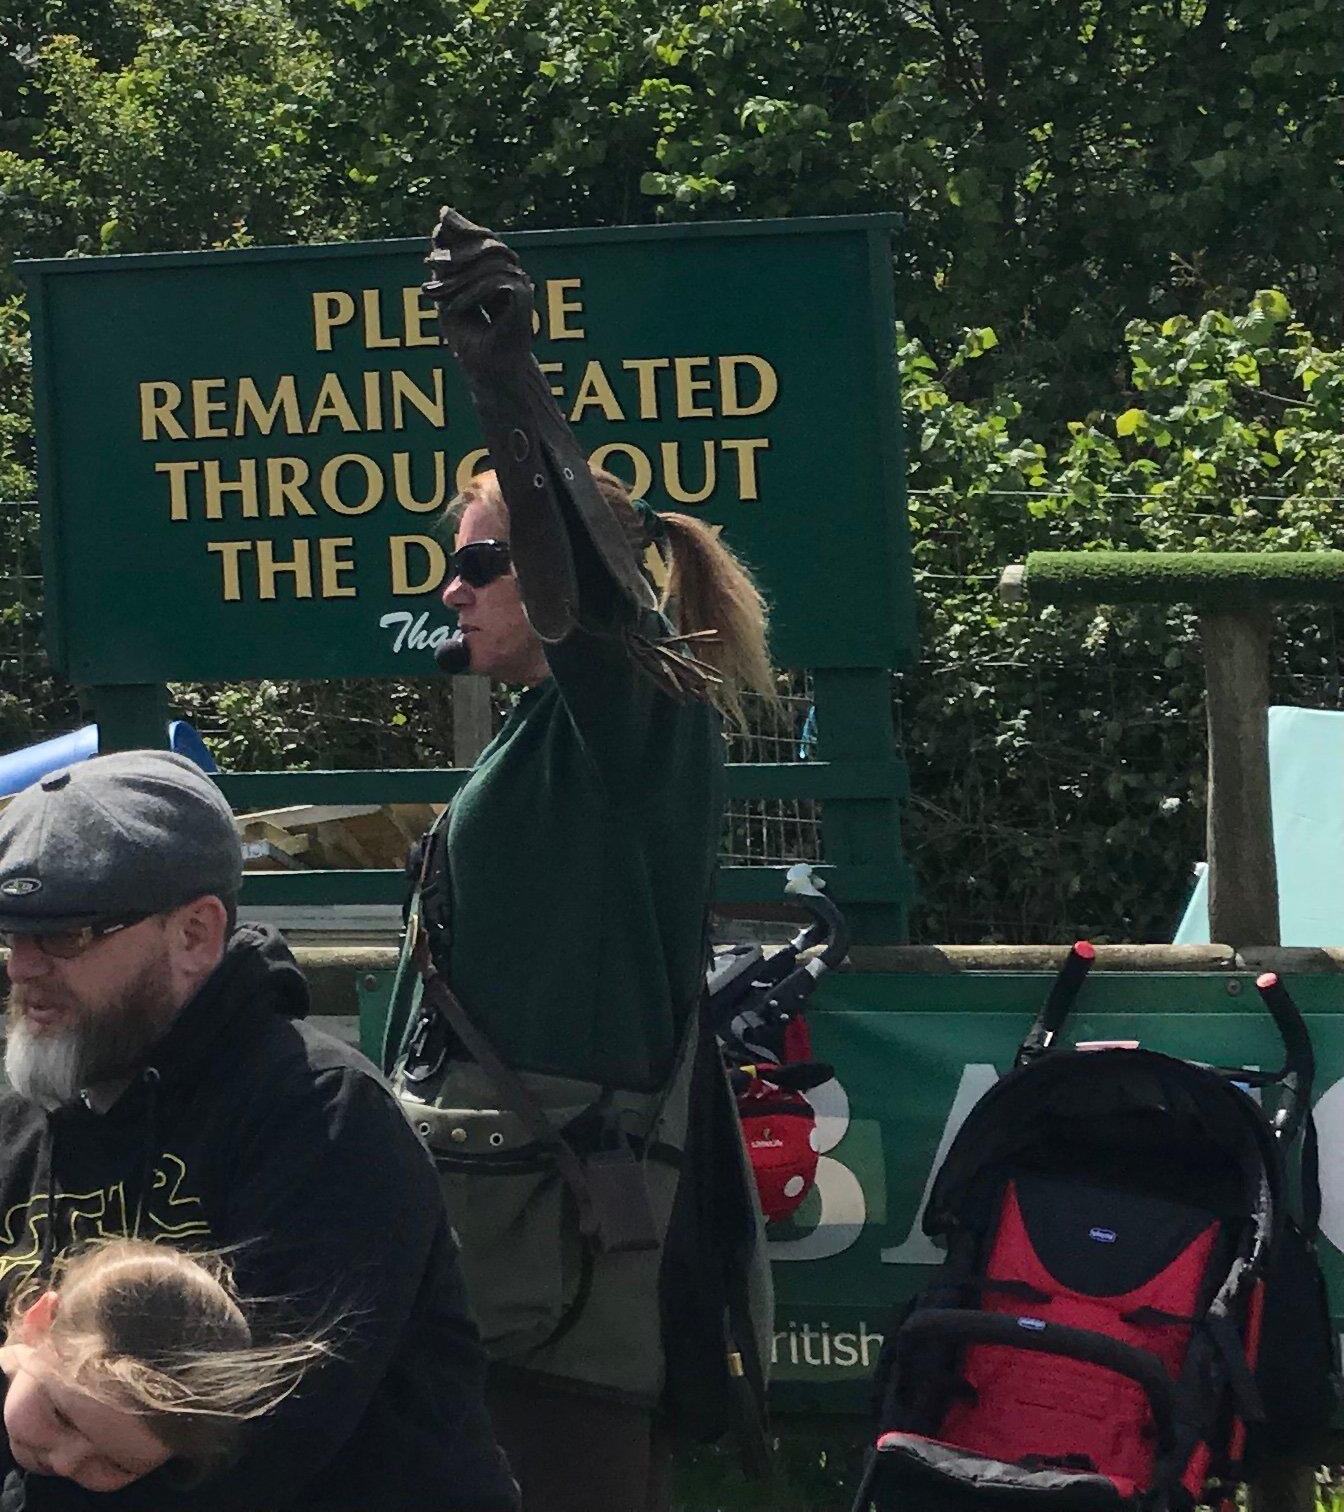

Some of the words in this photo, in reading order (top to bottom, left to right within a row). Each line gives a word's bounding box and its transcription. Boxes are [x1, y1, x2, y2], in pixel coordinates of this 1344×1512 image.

[312, 277, 585, 352] PLEE
[138, 369, 446, 442] REMAIN
[536, 352, 779, 423] ATED
[154, 437, 770, 521] THROUOUT
[206, 535, 358, 601] THE
[770, 1320, 885, 1367] ritish
